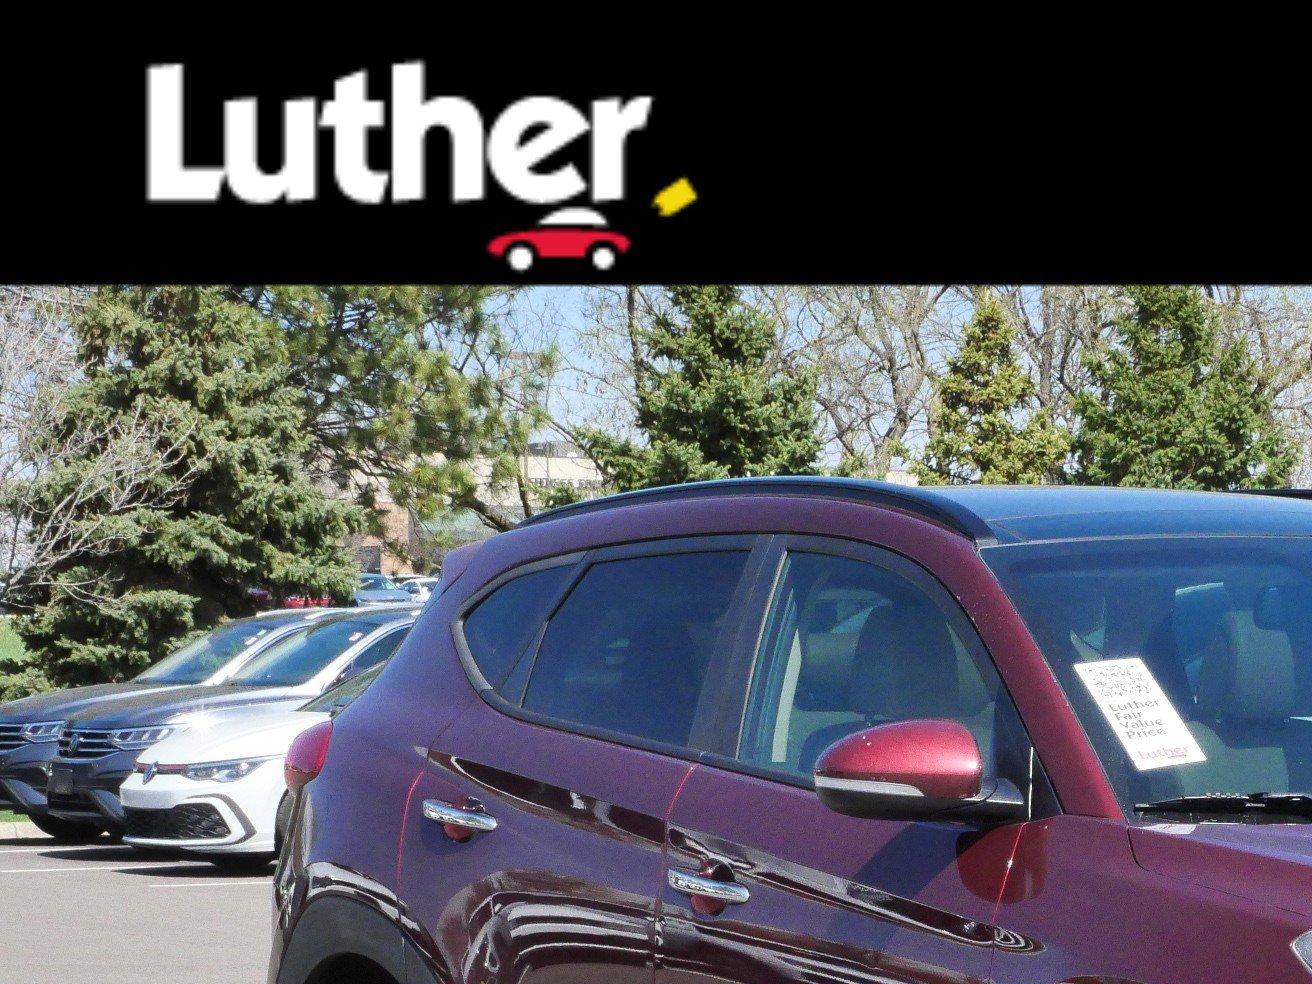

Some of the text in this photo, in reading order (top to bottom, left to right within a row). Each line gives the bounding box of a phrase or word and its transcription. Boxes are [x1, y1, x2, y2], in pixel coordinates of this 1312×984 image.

[1108, 700, 1159, 712] Luther
[1114, 711, 1143, 721] Fair
[1120, 718, 1165, 730] Value
[1125, 728, 1167, 739] Price
[1138, 746, 1189, 760] Luther
